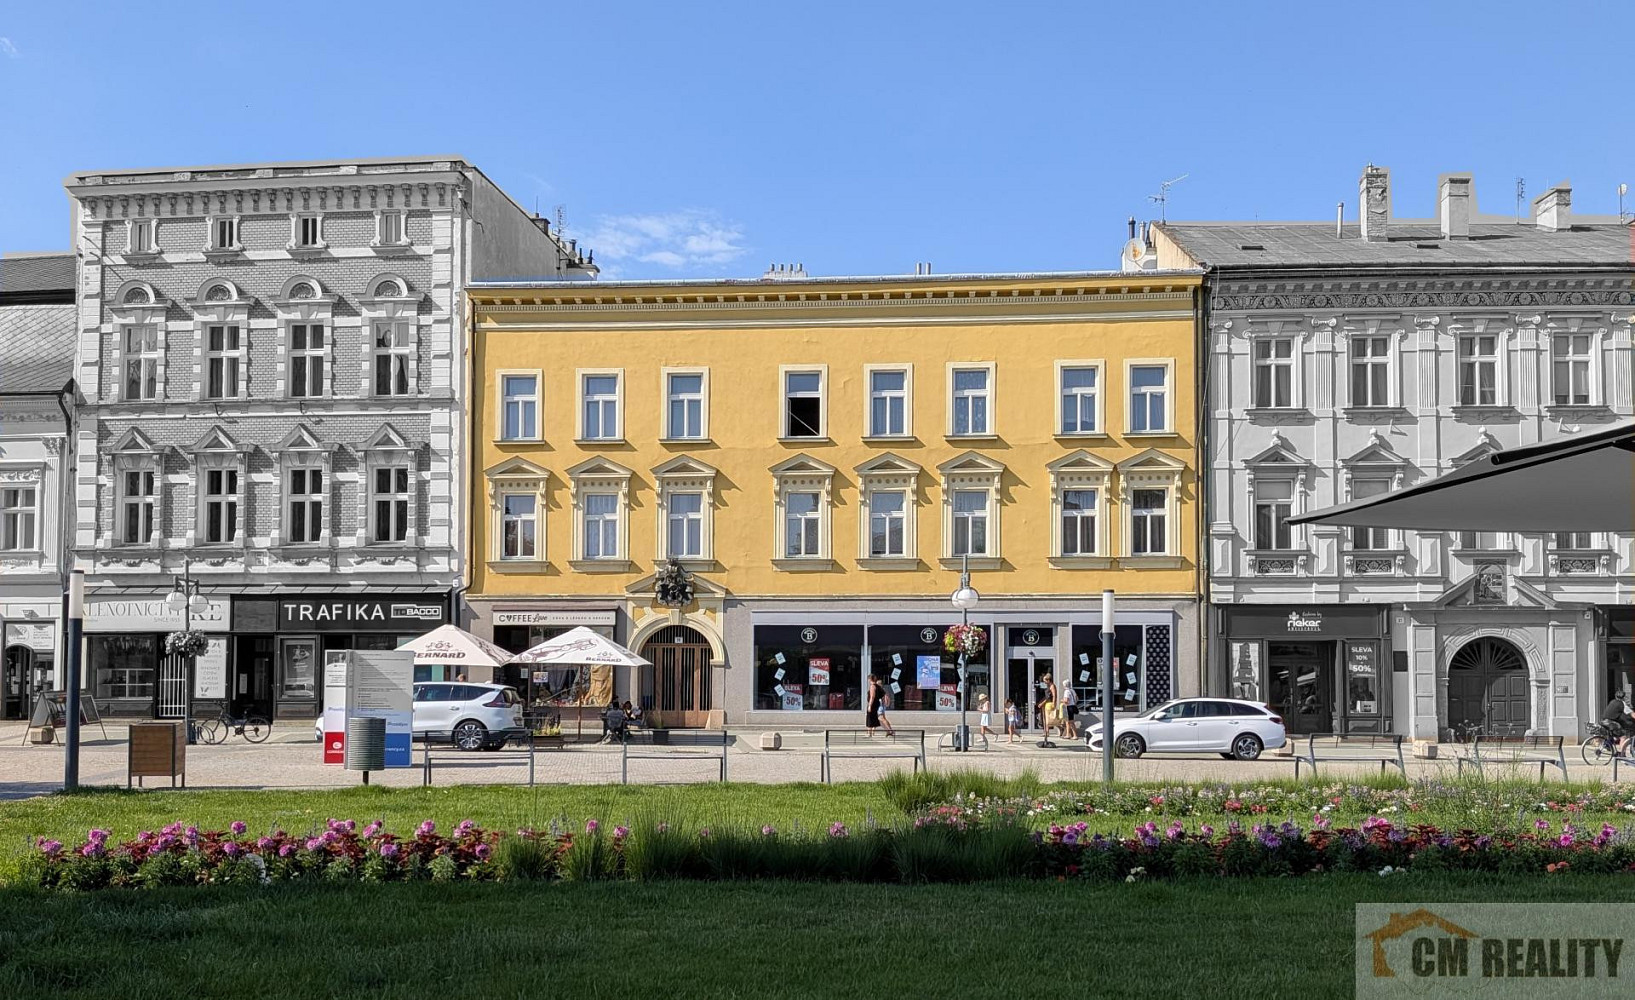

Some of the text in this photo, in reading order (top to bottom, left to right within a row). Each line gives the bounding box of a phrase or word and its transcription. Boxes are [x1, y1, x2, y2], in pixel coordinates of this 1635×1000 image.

[284, 603, 385, 621] TRAFIKA
[393, 608, 440, 616] TOBACCO
[1288, 617, 1321, 627] rieker
